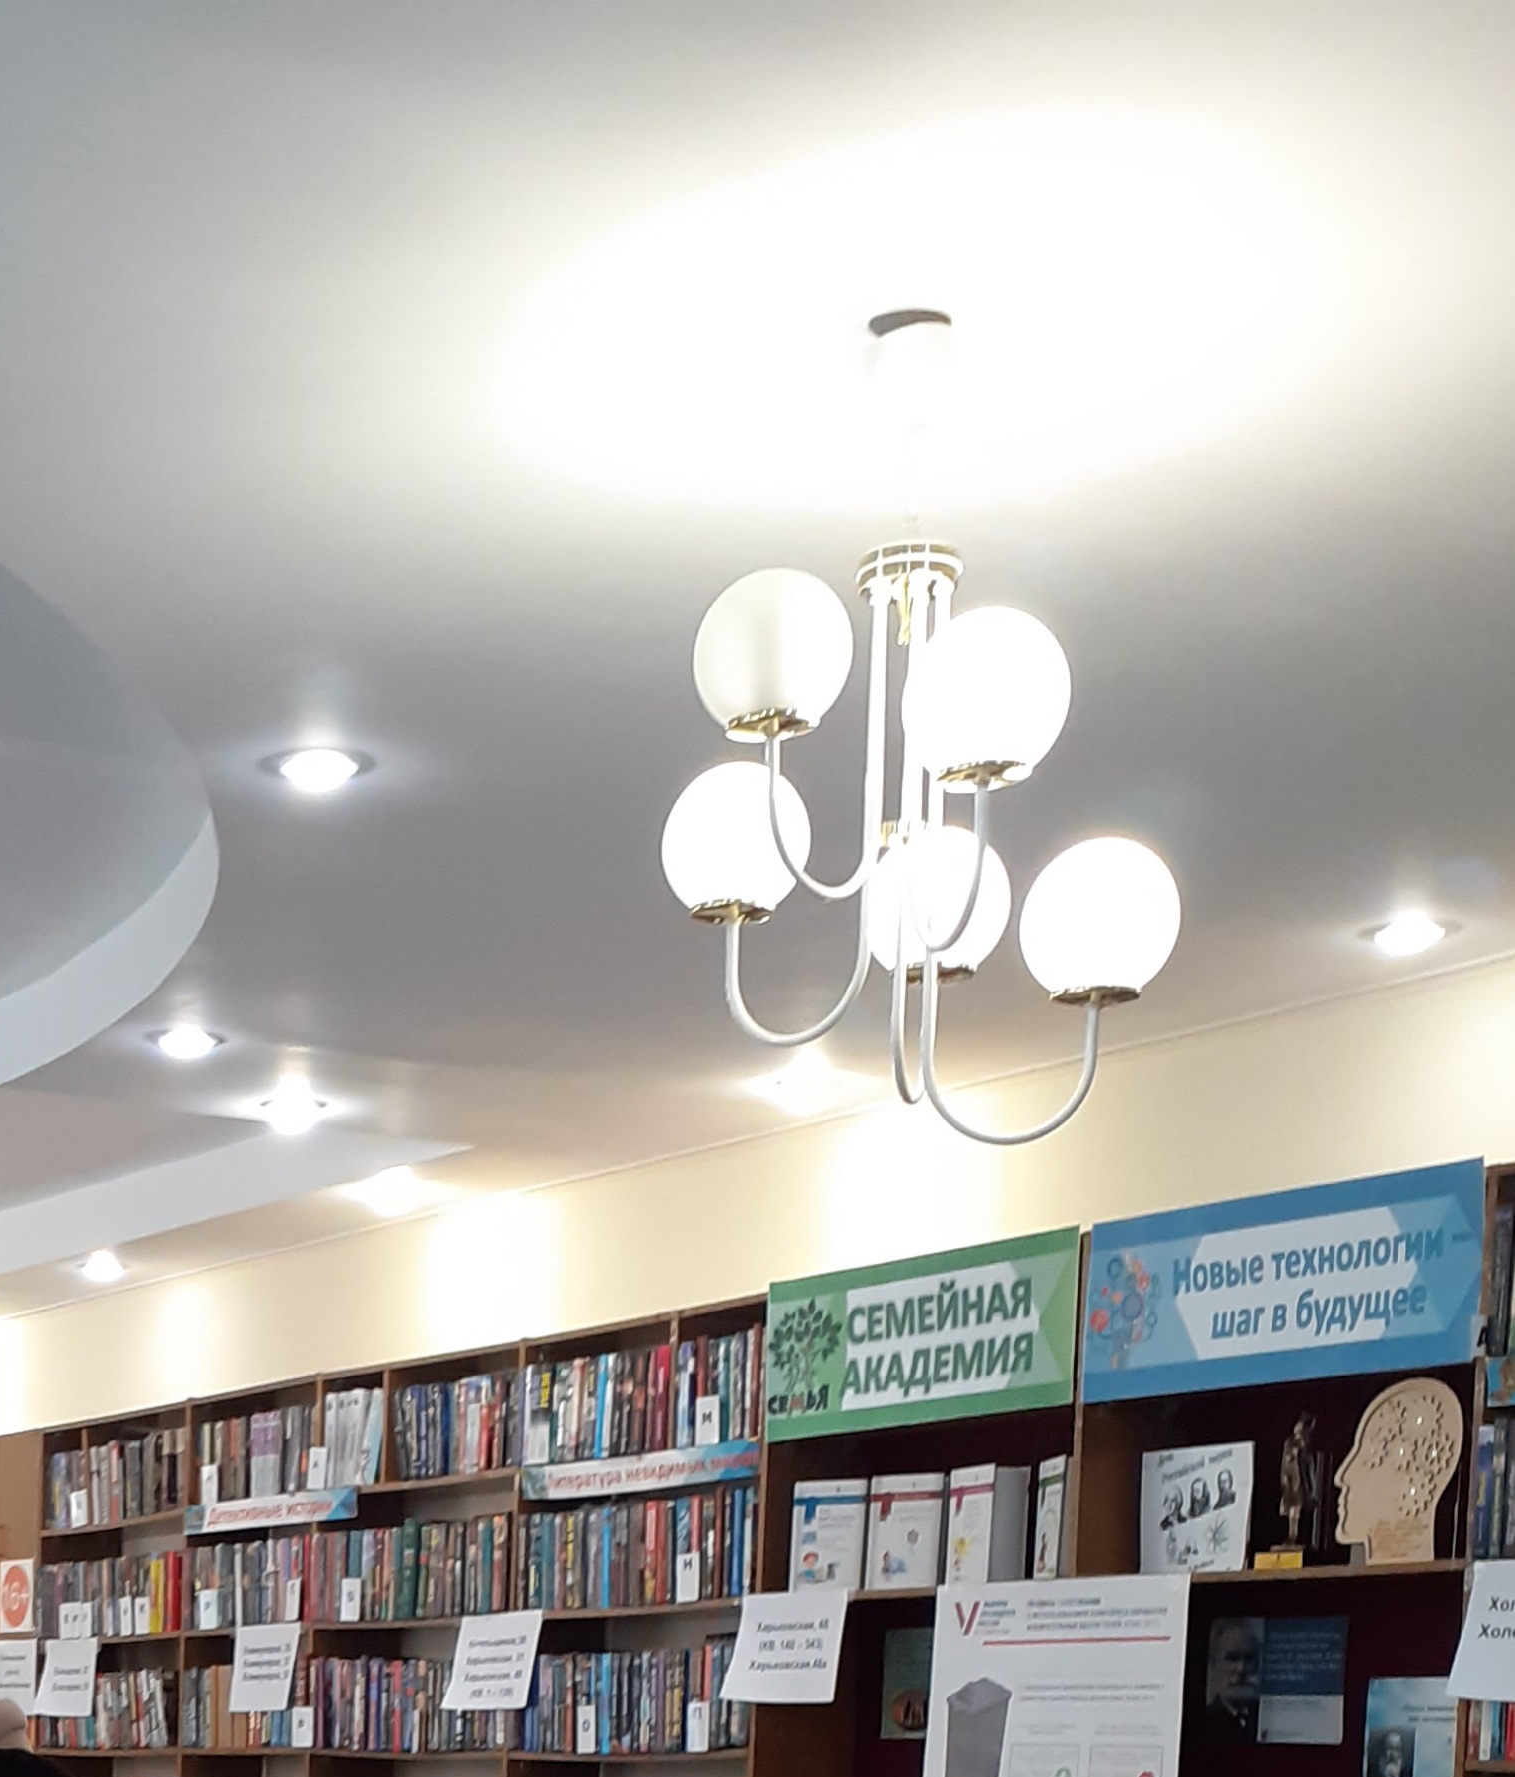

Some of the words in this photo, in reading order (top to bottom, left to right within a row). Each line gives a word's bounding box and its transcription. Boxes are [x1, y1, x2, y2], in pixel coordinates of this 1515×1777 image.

[1172, 1253, 1264, 1296] Новые
[1271, 1226, 1445, 1282] технологии
[847, 1278, 1032, 1345] СЕМЕЙНАЯ
[1210, 1305, 1265, 1340] шаг
[1271, 1303, 1287, 1333] в
[1295, 1285, 1428, 1337] будущее
[840, 1332, 1034, 1398] АКАДЕМИЯ
